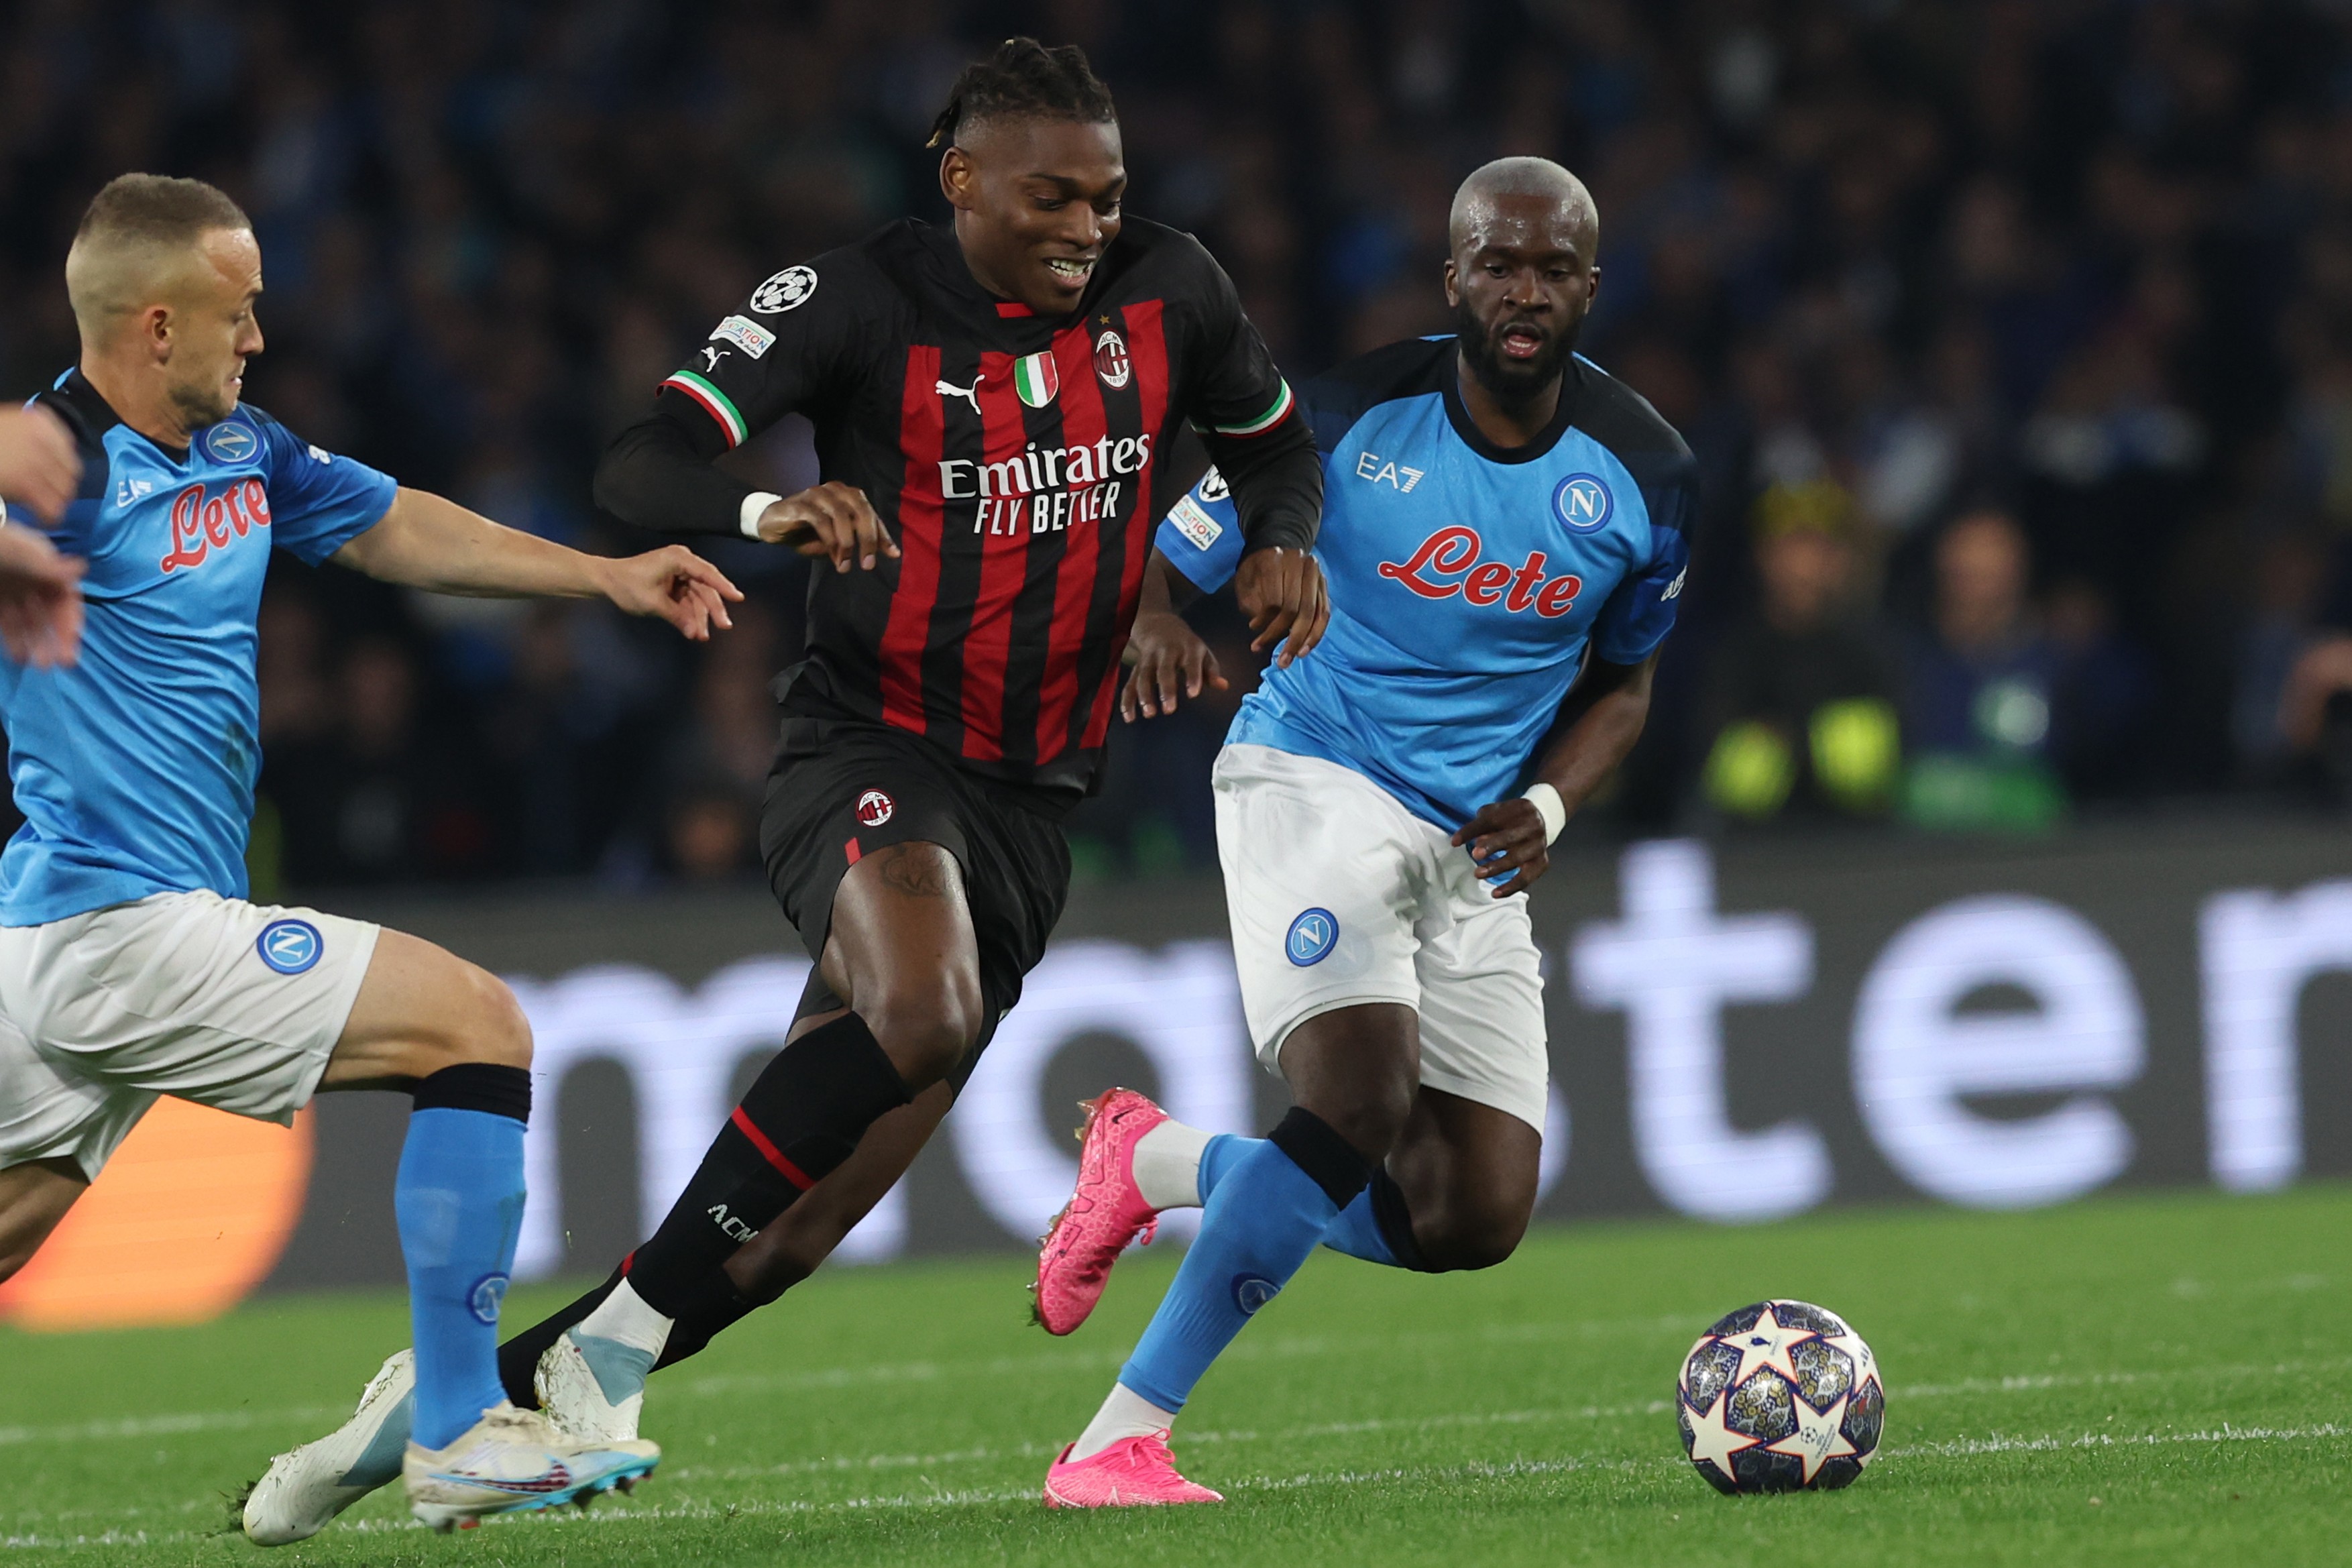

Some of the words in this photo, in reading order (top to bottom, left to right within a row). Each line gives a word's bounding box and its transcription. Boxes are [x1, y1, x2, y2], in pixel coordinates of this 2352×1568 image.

[1100, 333, 1119, 346] ACM
[213, 427, 250, 458] N
[937, 434, 1150, 498] Emirates
[1356, 451, 1424, 493] EA7
[974, 499, 1023, 535] FLY
[1033, 482, 1121, 533] BETTER
[1569, 488, 1598, 518] N
[160, 476, 272, 575] Lete
[1378, 524, 1581, 618] Lete
[862, 793, 883, 805] ACM
[272, 930, 307, 959] N
[1297, 919, 1321, 952] N
[707, 1204, 759, 1243] ACM
